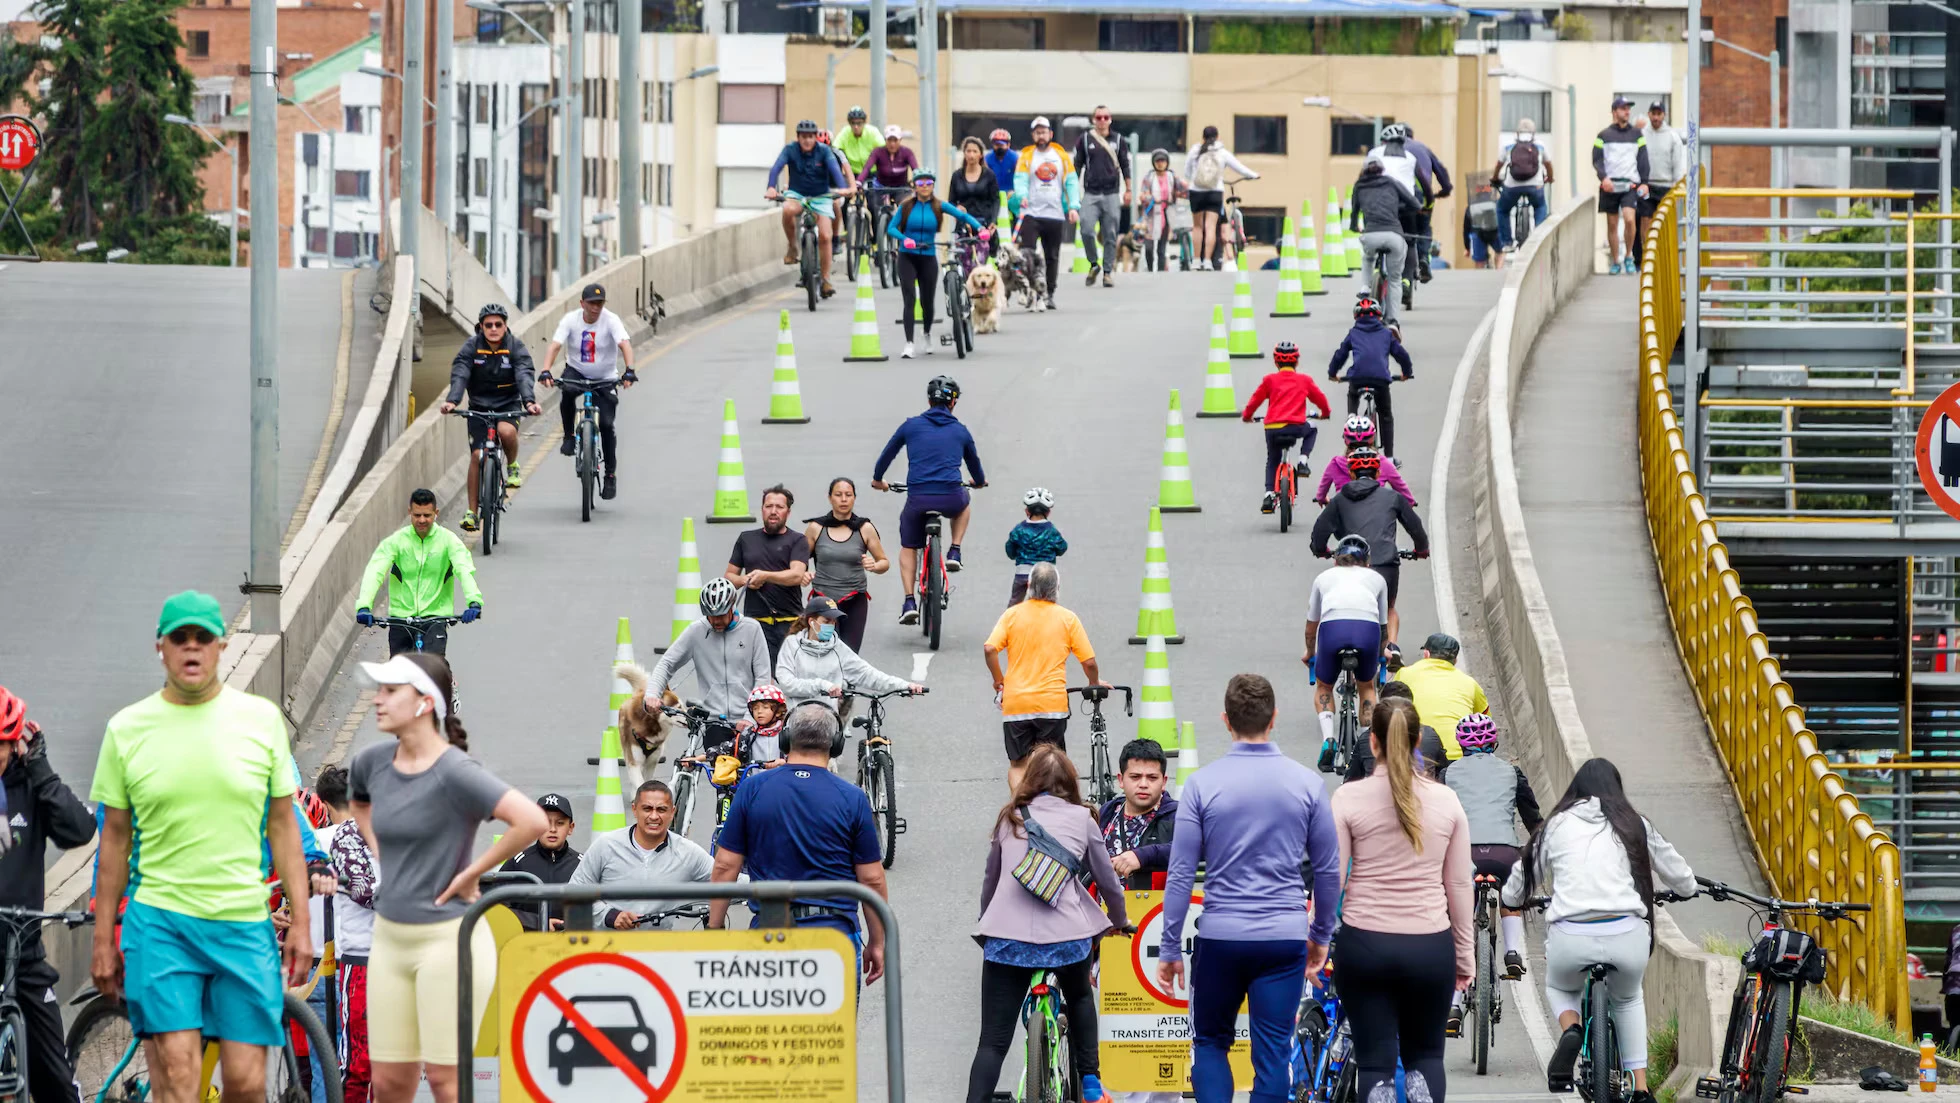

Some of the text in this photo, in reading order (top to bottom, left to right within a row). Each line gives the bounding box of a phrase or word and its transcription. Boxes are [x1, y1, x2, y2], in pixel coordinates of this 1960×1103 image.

[694, 955, 819, 979] TRÁNSITO
[687, 989, 827, 1009] EXCLUSIVO
[1157, 1017, 1188, 1027] ¡ATEN
[700, 1022, 844, 1036] HORARIO DE LA CICLOVÍA
[1111, 1029, 1190, 1038] TRANSITE POR
[700, 1038, 844, 1051] DOMINGOS Y FESTIVOS
[702, 1055, 718, 1066] DE
[778, 1056, 786, 1066] a
[788, 1054, 814, 1067] 2:00
